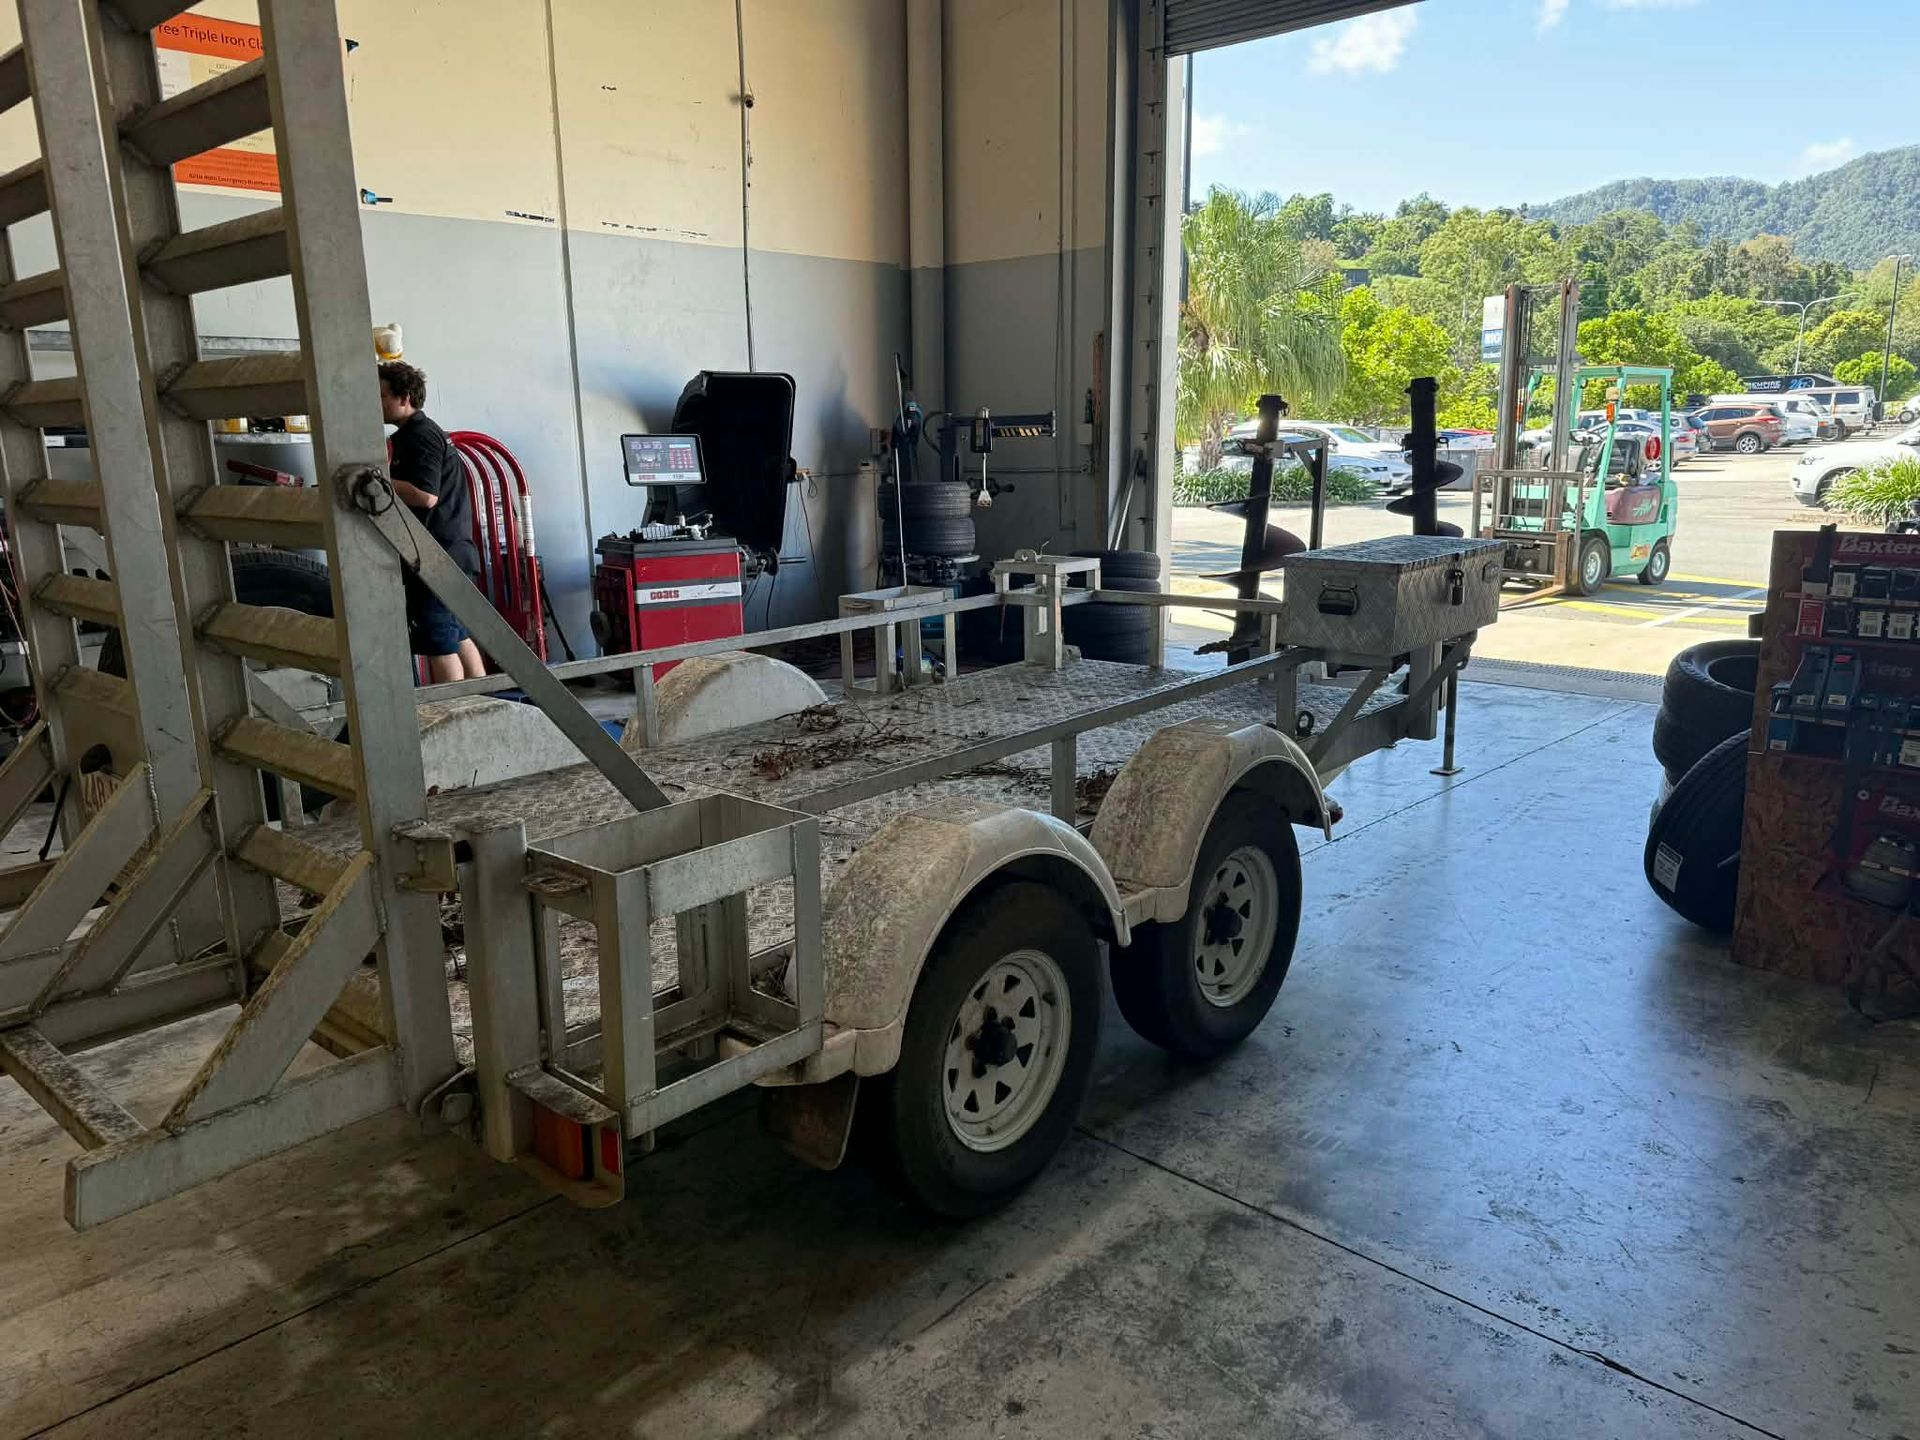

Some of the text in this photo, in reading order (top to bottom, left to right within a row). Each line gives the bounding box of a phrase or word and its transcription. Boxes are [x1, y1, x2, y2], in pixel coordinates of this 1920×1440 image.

[159, 24, 263, 50] ree Triple Iron Cl
